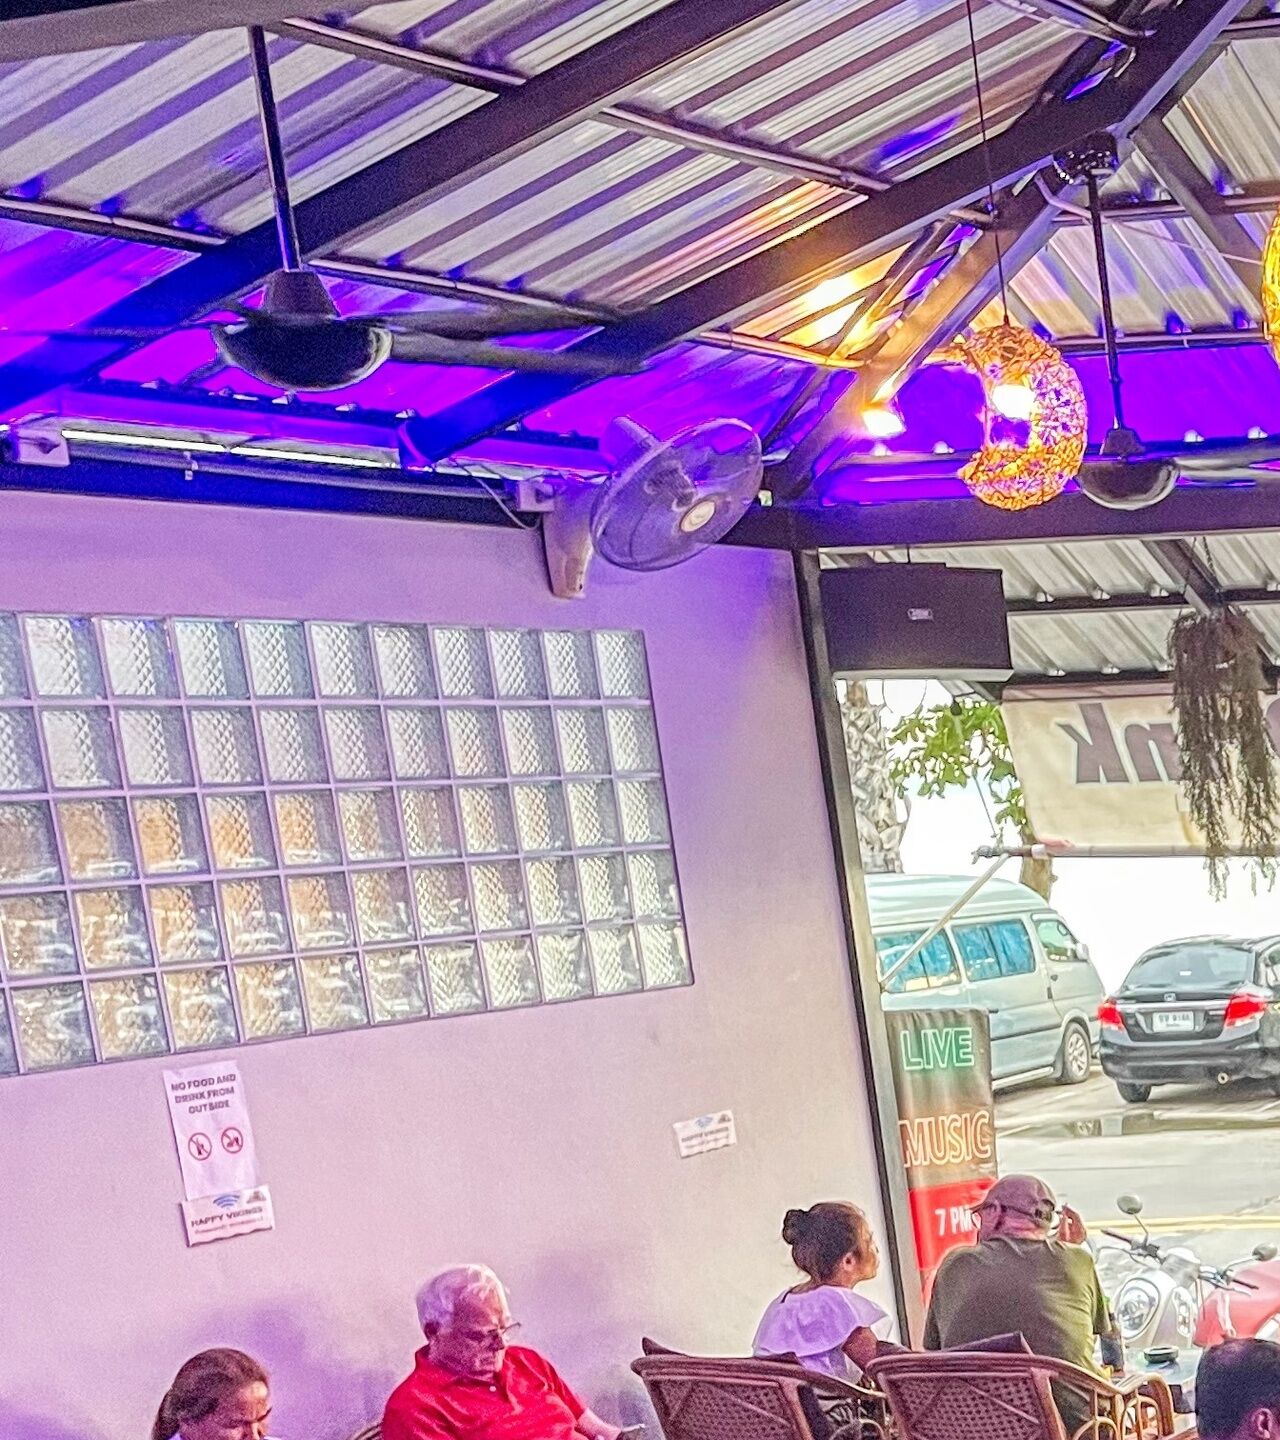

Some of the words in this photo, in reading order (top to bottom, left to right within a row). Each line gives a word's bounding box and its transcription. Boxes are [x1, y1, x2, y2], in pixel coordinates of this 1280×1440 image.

[900, 1027, 974, 1070] LIVE
[171, 1082, 186, 1091] NO
[187, 1077, 215, 1089] FOOD
[216, 1074, 236, 1085] AND
[174, 1091, 206, 1104] DRINK
[206, 1086, 235, 1099] FROM
[898, 1110, 992, 1168] MUSIC
[934, 1208, 946, 1237] 7
